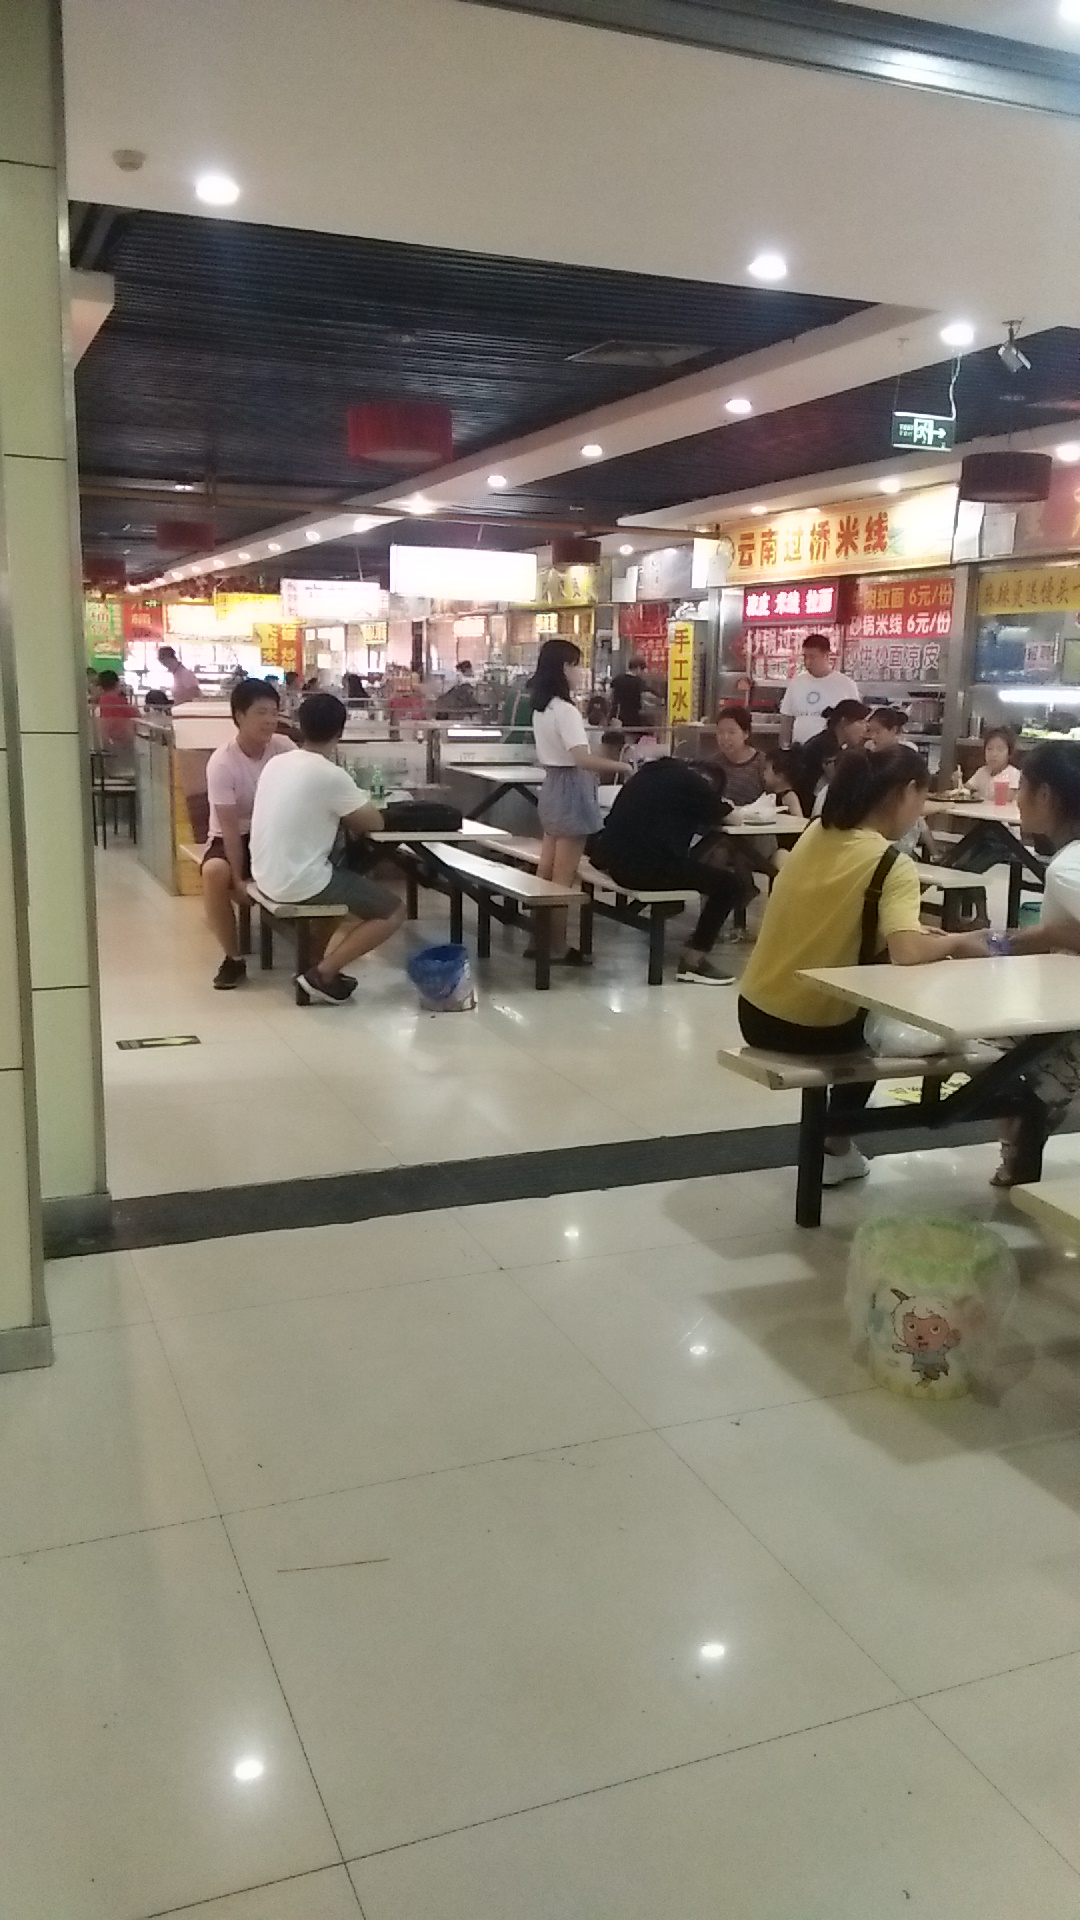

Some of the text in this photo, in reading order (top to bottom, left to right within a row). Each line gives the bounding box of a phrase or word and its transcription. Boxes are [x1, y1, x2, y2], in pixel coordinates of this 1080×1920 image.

[737, 512, 888, 567] 云南过桥米线
[909, 582, 952, 606] 6元/份
[849, 610, 951, 636] 砂锅米线 6元/份
